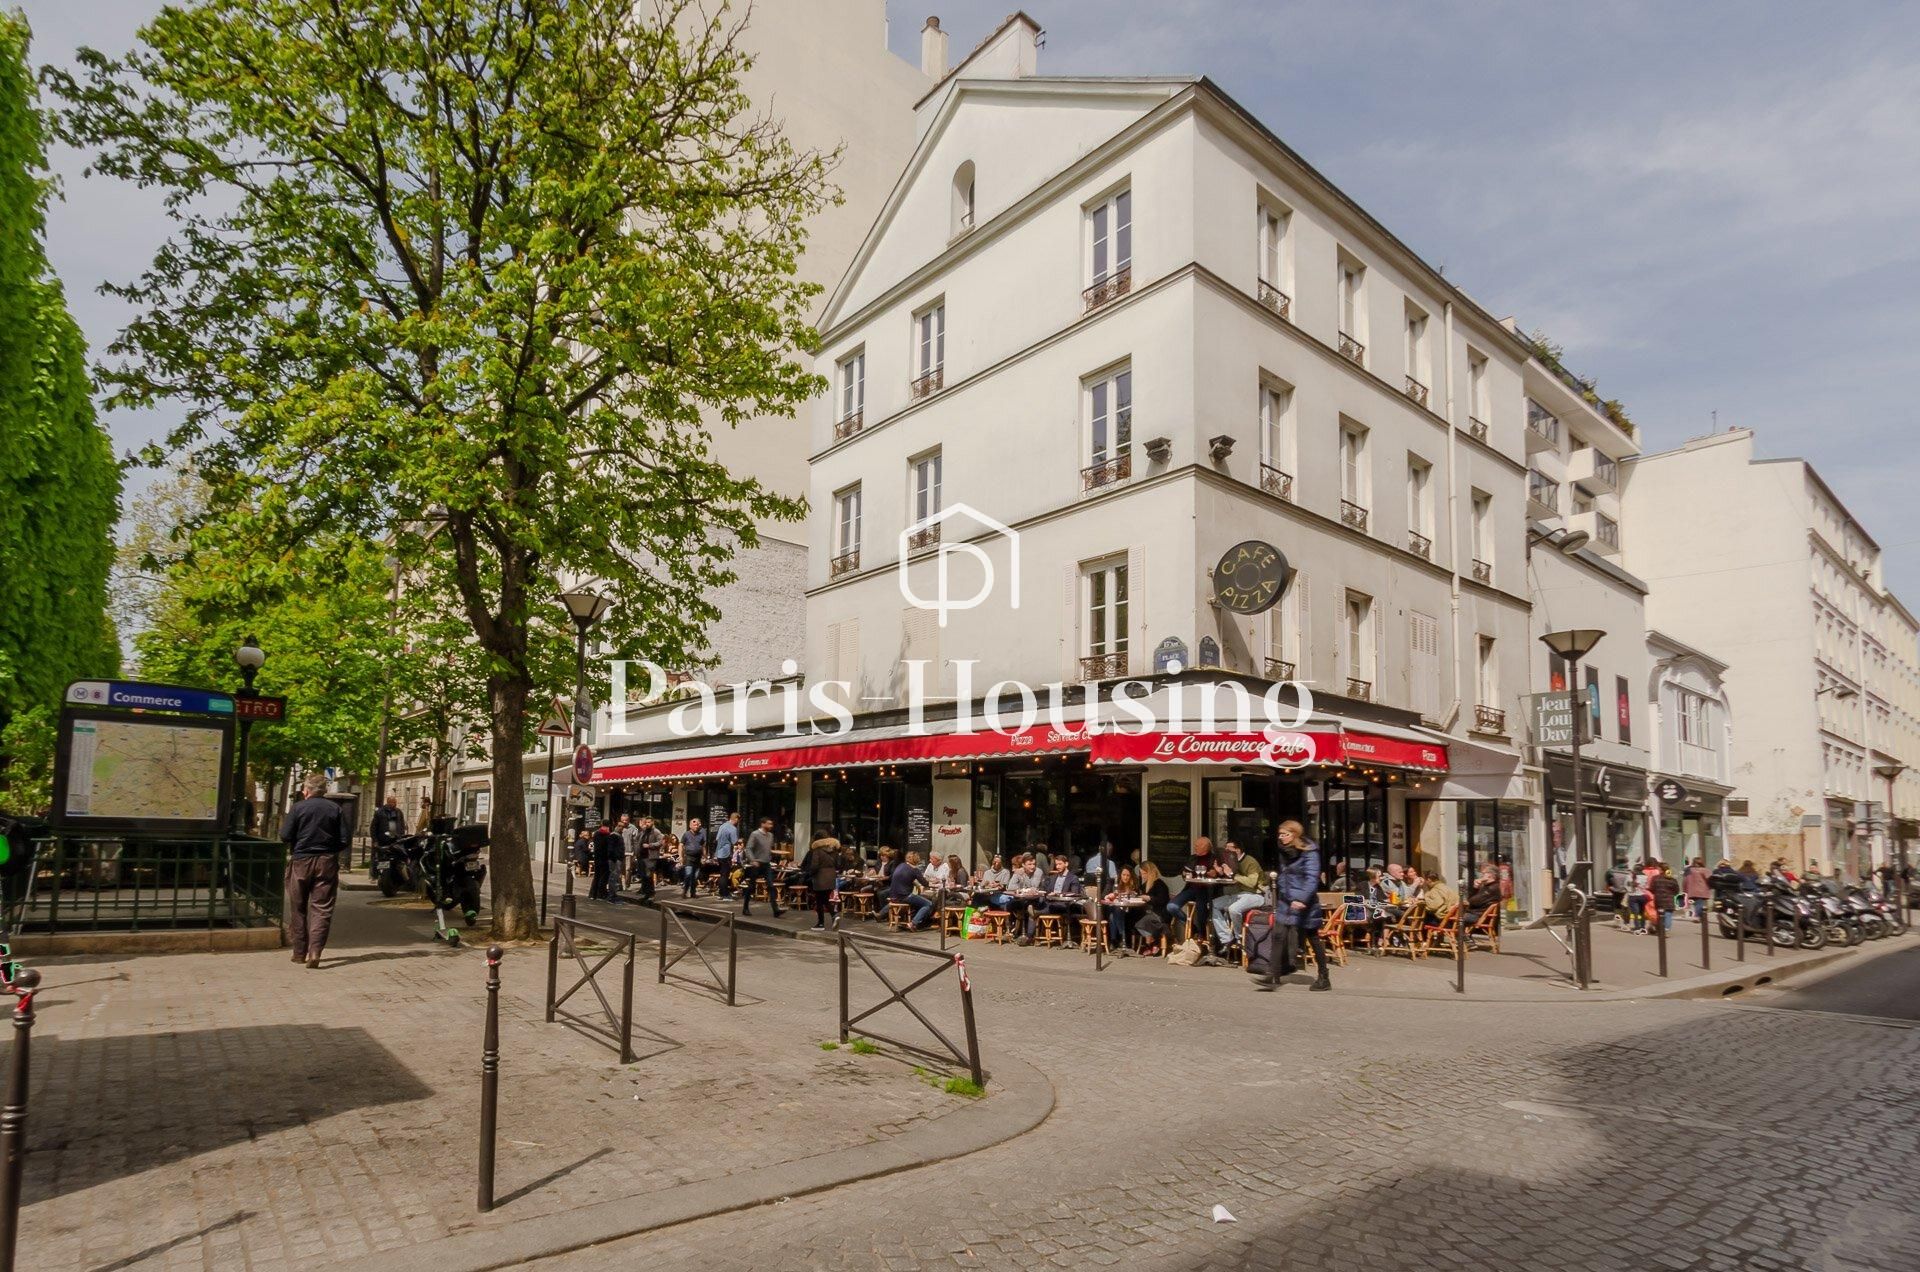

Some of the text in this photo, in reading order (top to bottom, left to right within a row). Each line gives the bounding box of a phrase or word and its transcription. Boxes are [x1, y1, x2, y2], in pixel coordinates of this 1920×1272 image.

[1220, 580, 1277, 609] PIZZA
[113, 692, 182, 707] Commerce
[1539, 711, 1572, 726] Loui
[1540, 727, 1573, 741] Dav
[1153, 736, 1306, 756] Le Commerce Café
[535, 777, 545, 786] 21
